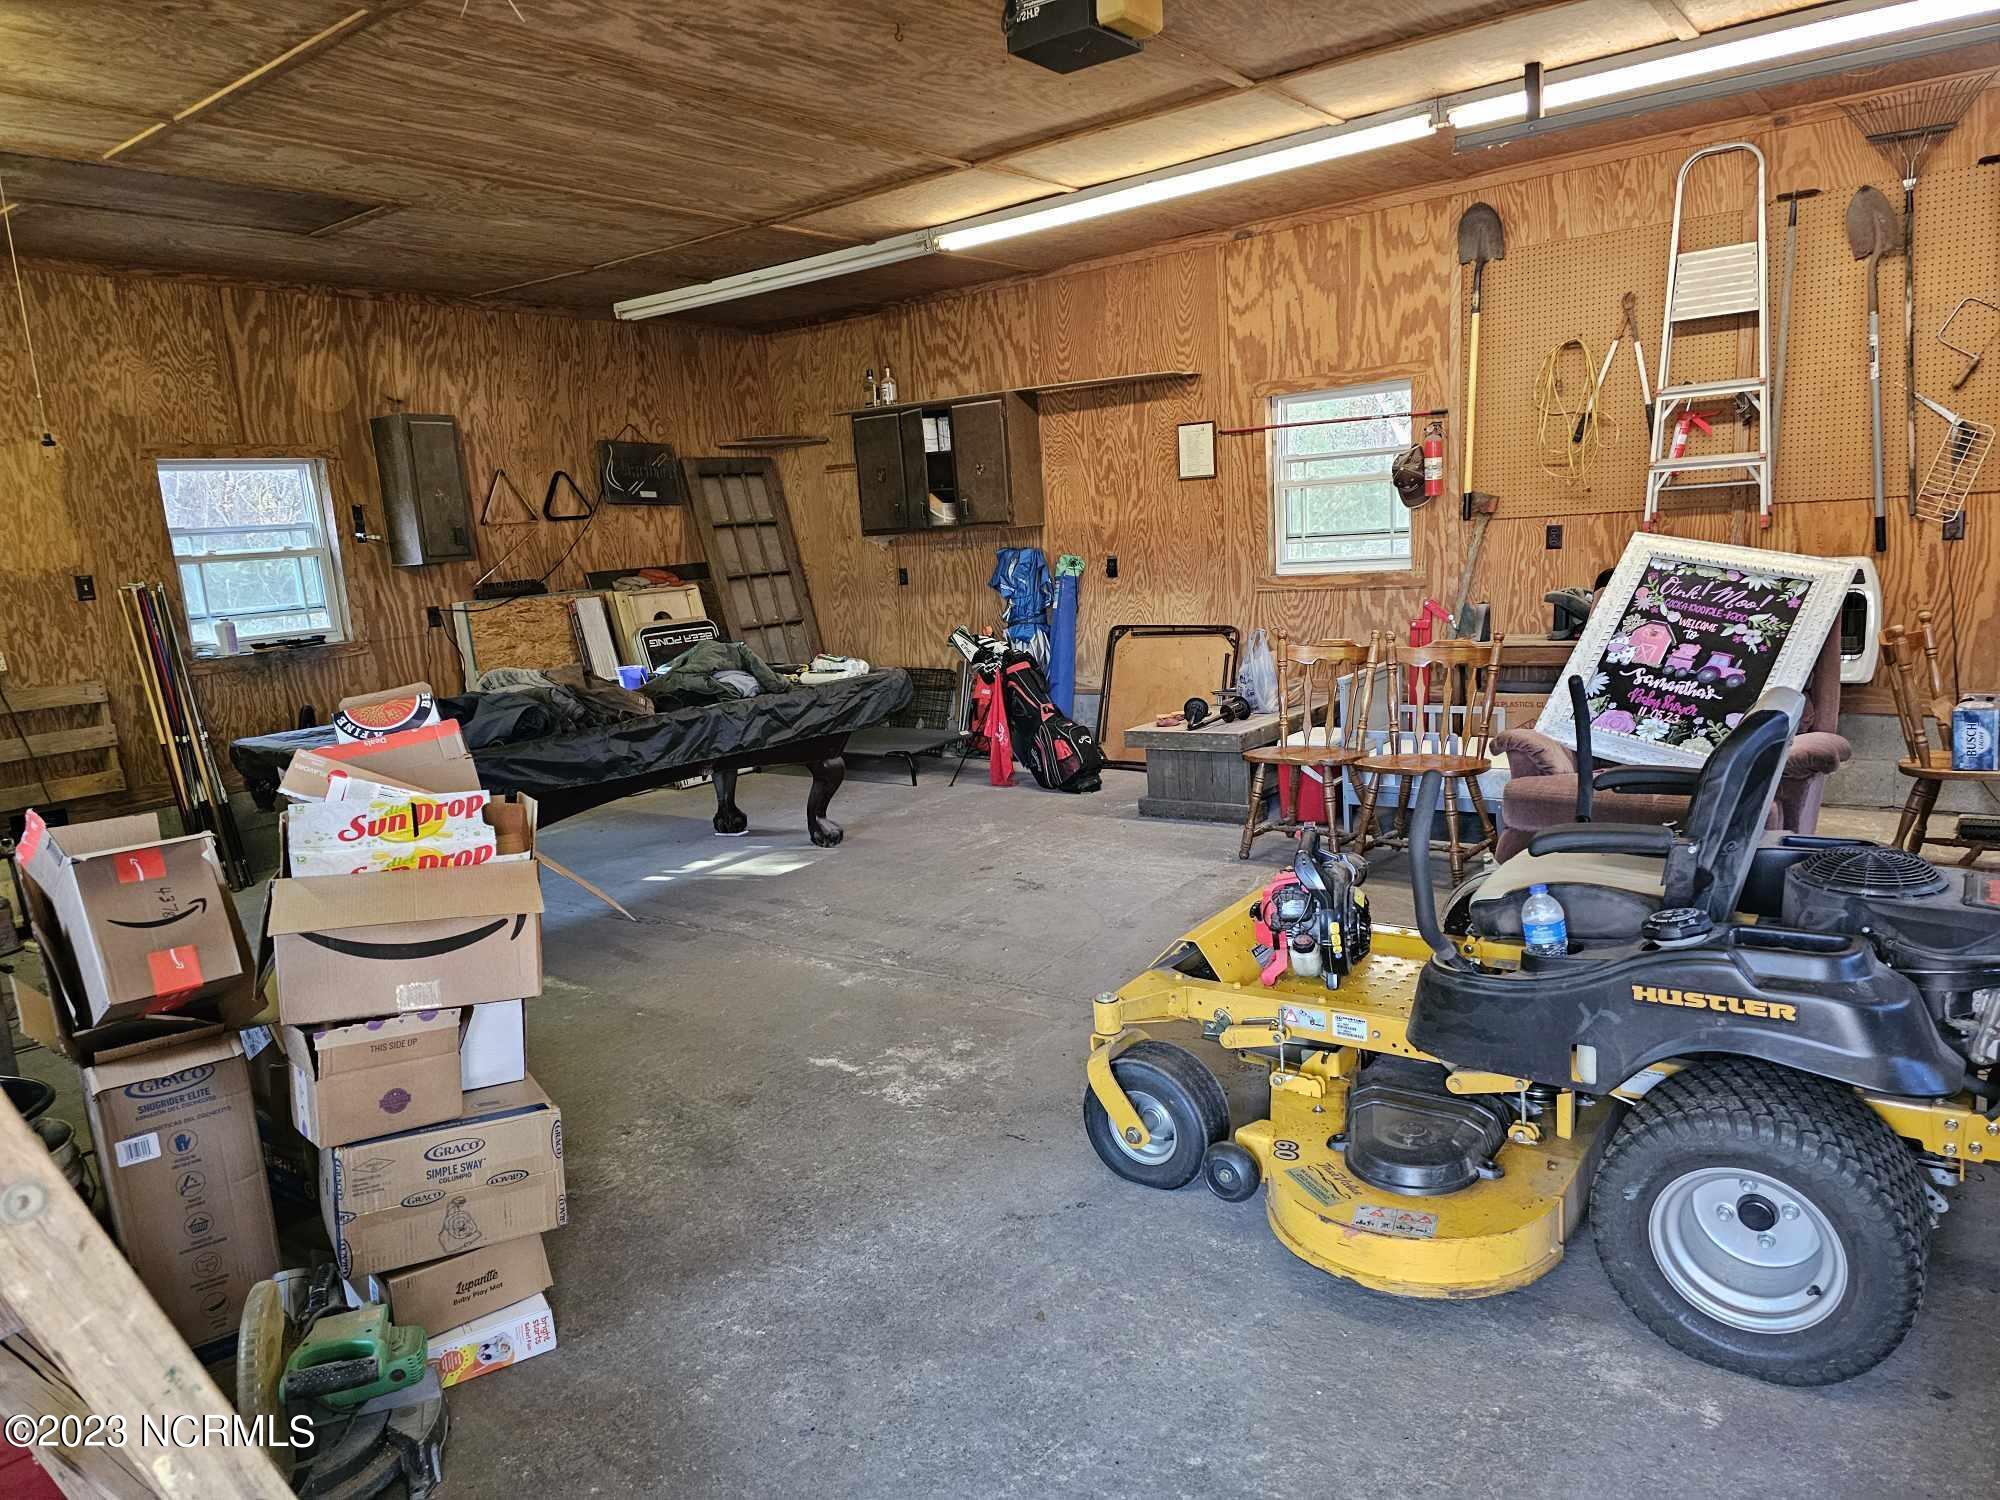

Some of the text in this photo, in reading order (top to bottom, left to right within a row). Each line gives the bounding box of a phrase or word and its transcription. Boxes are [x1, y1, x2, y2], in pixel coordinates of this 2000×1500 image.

[1710, 586, 1775, 611] Moo!
[1679, 617, 1719, 633] WELCOME
[1683, 629, 1700, 640] to
[649, 631, 714, 648] BEER PONG
[1619, 667, 1723, 699] Samantha's
[1627, 687, 1698, 716] Baby Shower
[1966, 722, 1978, 757] BUSCH
[337, 794, 484, 842] Sun Drop
[1631, 984, 1797, 1022] HUSTLER
[370, 1038, 418, 1053] THIS SIDE UP
[187, 1086, 211, 1102] ELITE
[433, 1141, 480, 1157] GRACO
[553, 1122, 562, 1156] GRACO
[1273, 1139, 1300, 1161] 60
[426, 1158, 484, 1181] SIMPLE SWAY
[438, 1172, 472, 1185] COLUMPIO
[489, 1171, 525, 1185] GRACO
[404, 1190, 443, 1206] GRACO
[453, 1281, 504, 1306] Baby Play Mat
[455, 1269, 499, 1295] Lupantte
[532, 1318, 541, 1345] starts
[540, 1315, 551, 1342] bright
